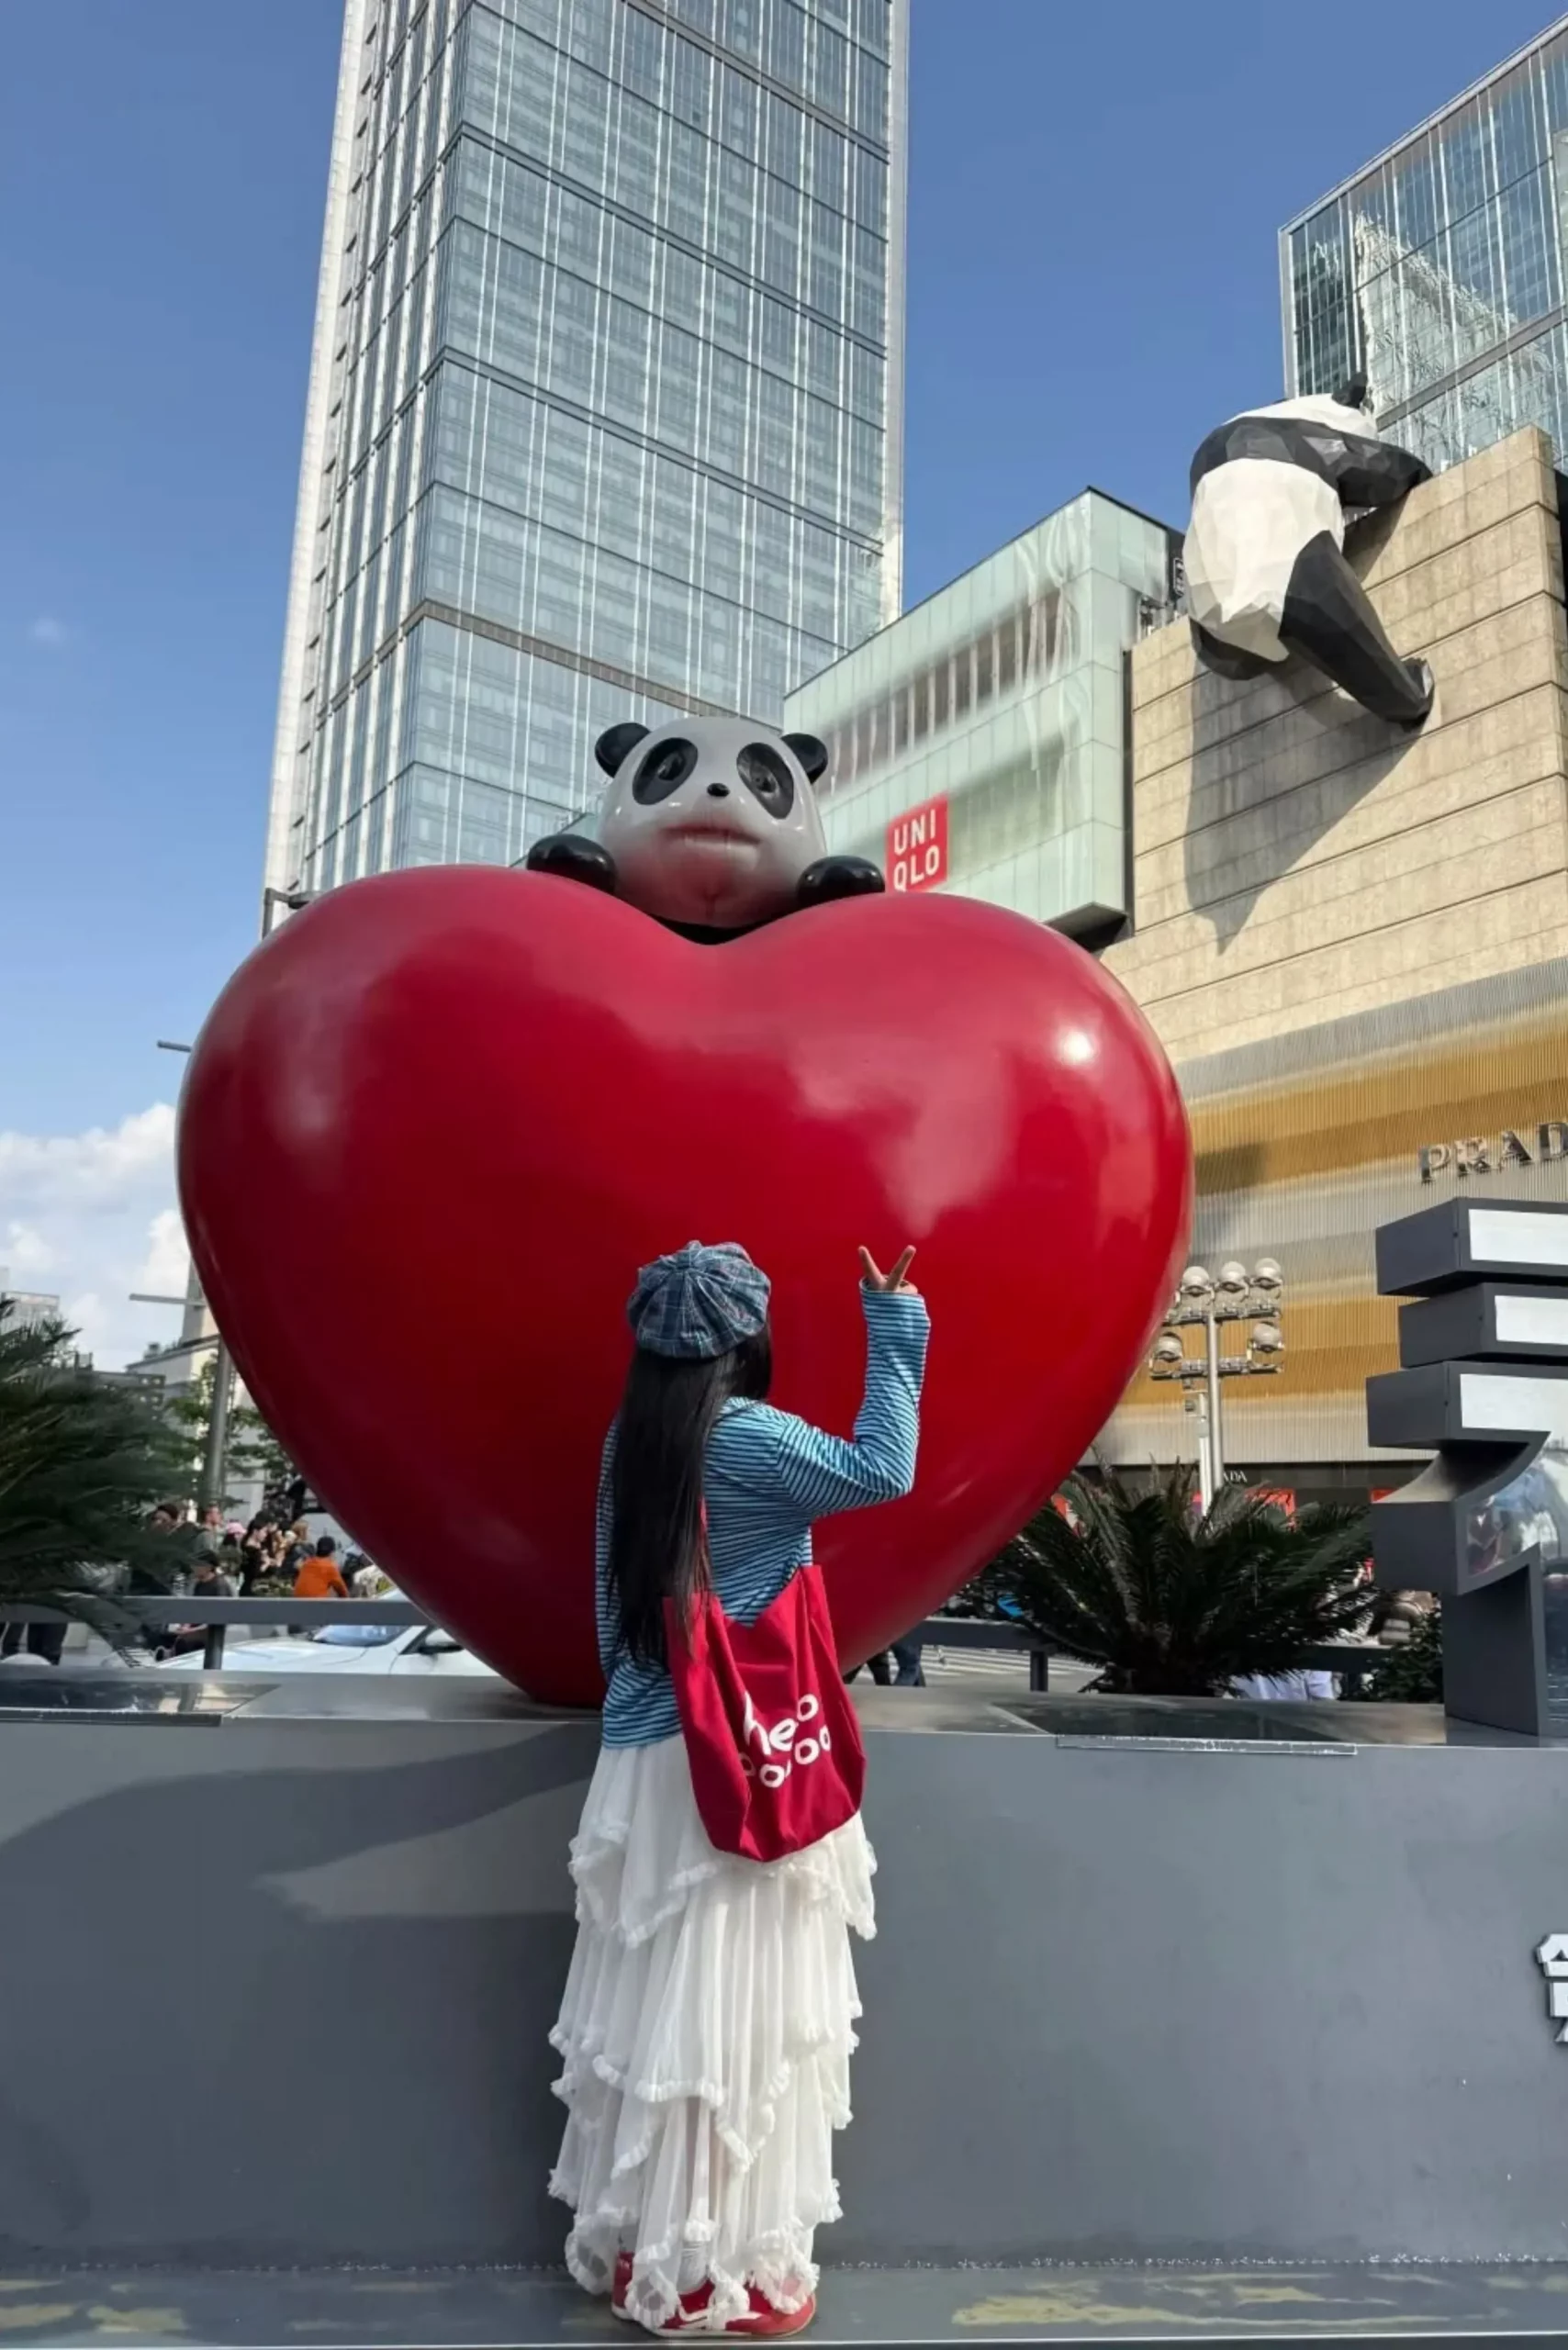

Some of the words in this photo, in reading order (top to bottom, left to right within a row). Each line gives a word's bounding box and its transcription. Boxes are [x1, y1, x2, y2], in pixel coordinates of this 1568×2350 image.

[893, 809, 936, 856] UNI
[893, 845, 940, 892] QLO
[1418, 1123, 1568, 1184] PRAD
